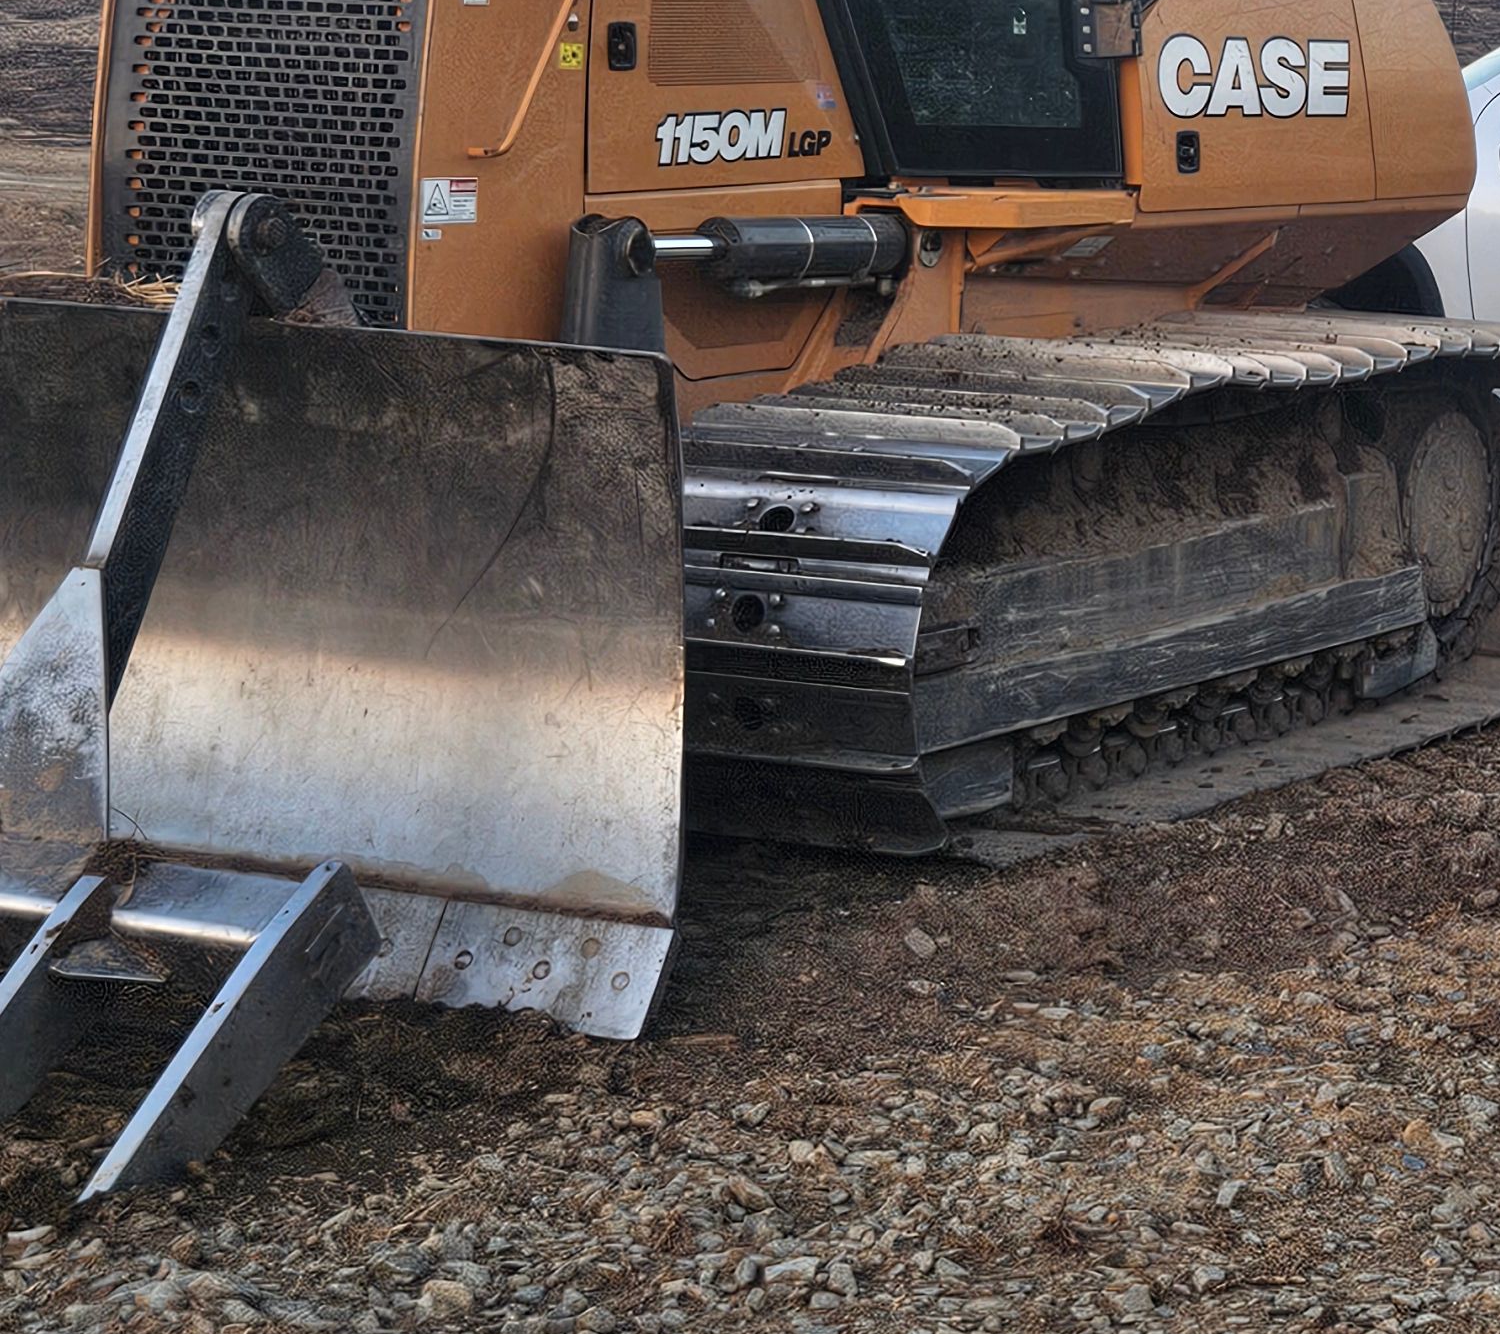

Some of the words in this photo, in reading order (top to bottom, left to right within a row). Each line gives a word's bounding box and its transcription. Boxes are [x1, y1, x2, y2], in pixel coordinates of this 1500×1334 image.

[1158, 33, 1350, 119] CASE
[655, 108, 787, 167] 1150M
[788, 130, 832, 157] LGP
